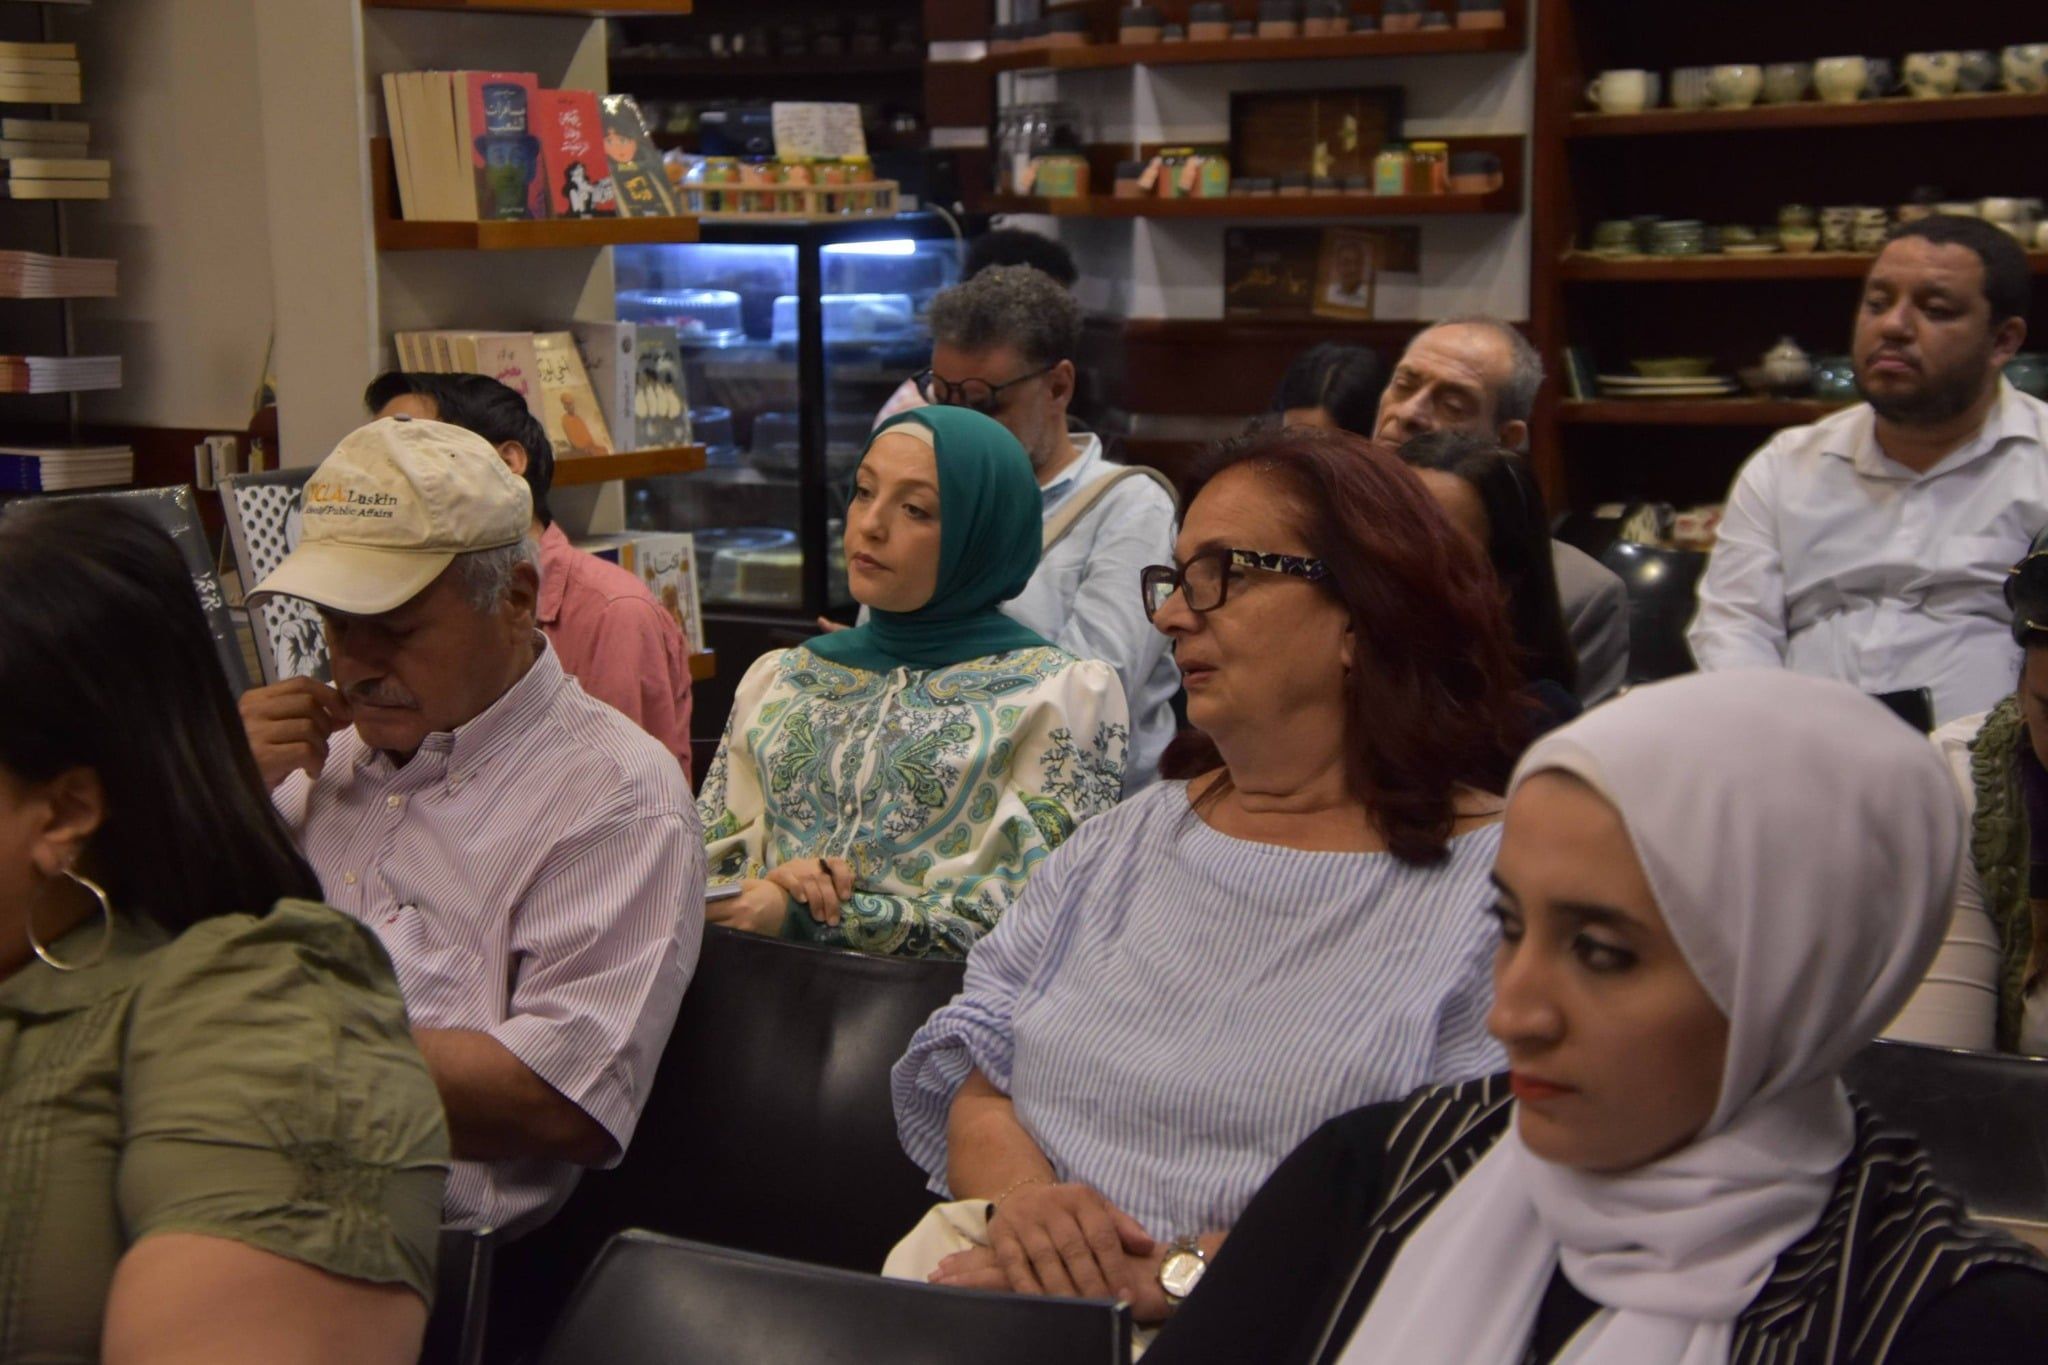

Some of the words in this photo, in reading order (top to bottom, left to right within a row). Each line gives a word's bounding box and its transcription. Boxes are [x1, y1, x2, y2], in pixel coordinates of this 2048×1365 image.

[347, 490, 398, 505] Luskin
[327, 504, 356, 515] Public
[357, 508, 393, 518] Affairs
